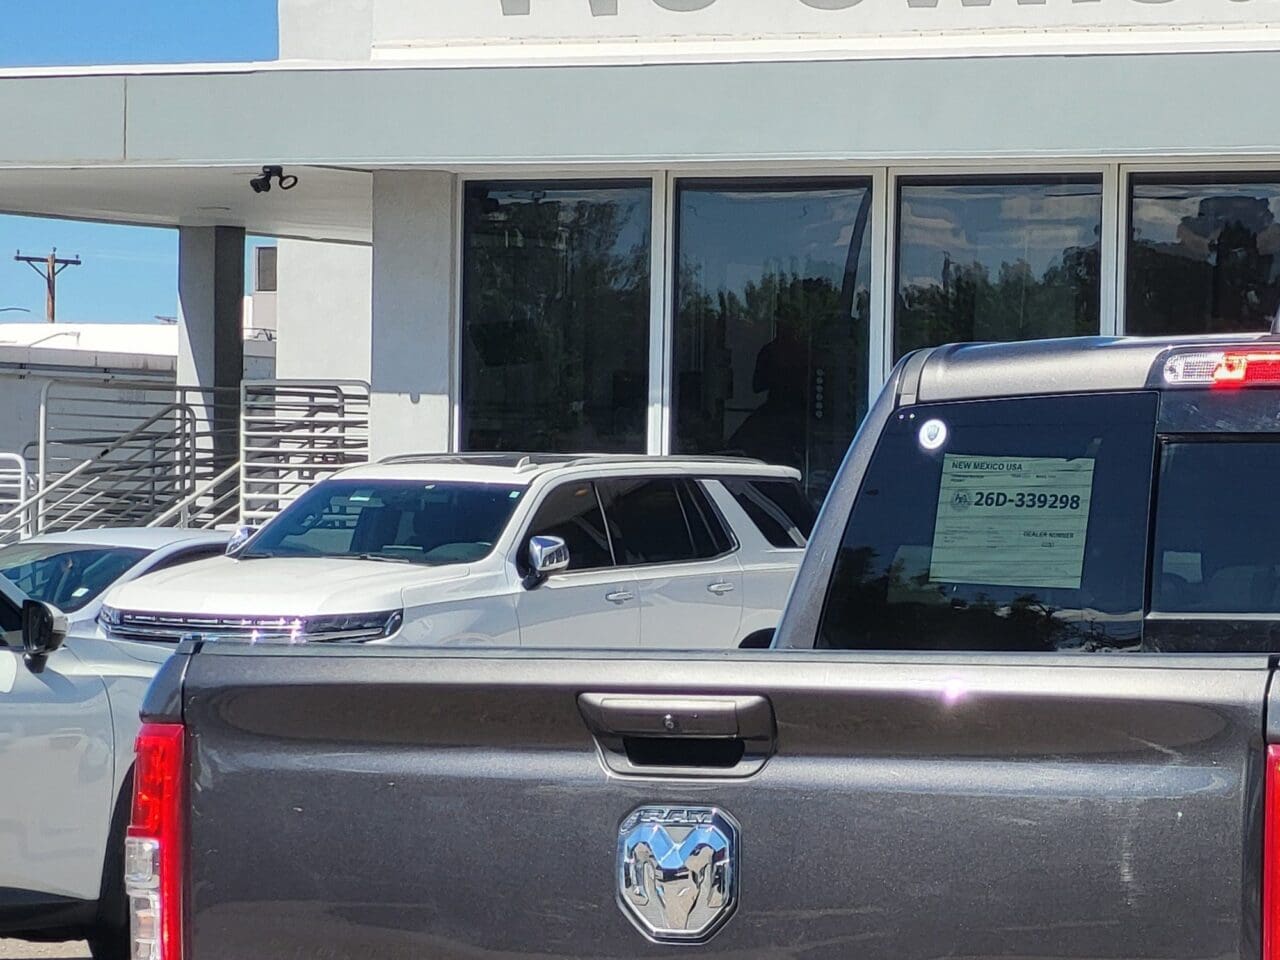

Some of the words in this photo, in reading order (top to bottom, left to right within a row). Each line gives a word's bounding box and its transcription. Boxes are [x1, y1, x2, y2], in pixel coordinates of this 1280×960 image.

[951, 461, 971, 470] NEW
[973, 462, 1005, 471] MEXICO
[1006, 463, 1023, 471] USA
[974, 491, 1081, 510] 26D-339298
